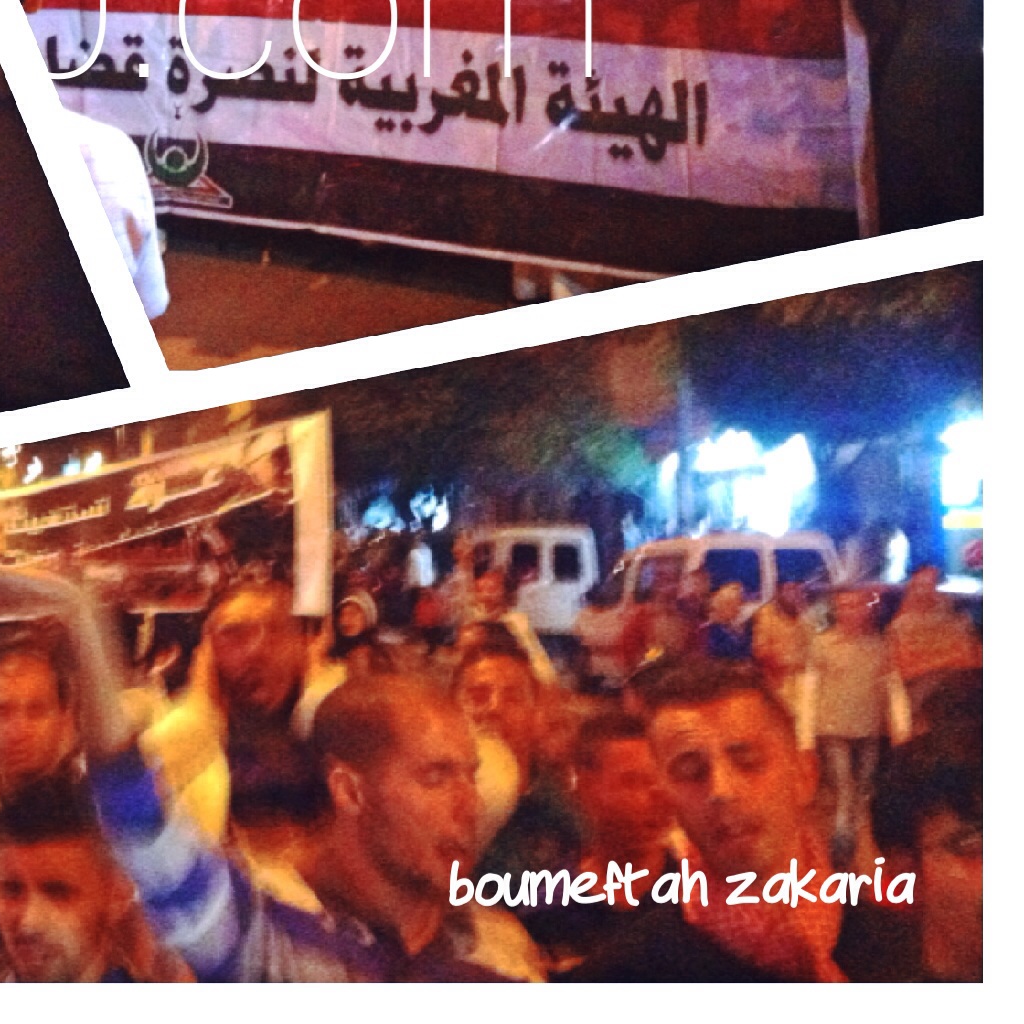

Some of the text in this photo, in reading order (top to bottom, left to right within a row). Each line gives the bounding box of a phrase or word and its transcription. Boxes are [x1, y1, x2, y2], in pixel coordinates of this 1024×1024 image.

[168, 34, 322, 115] لنصرة
[339, 44, 527, 135] المغربية
[545, 60, 708, 161] الهيئة
